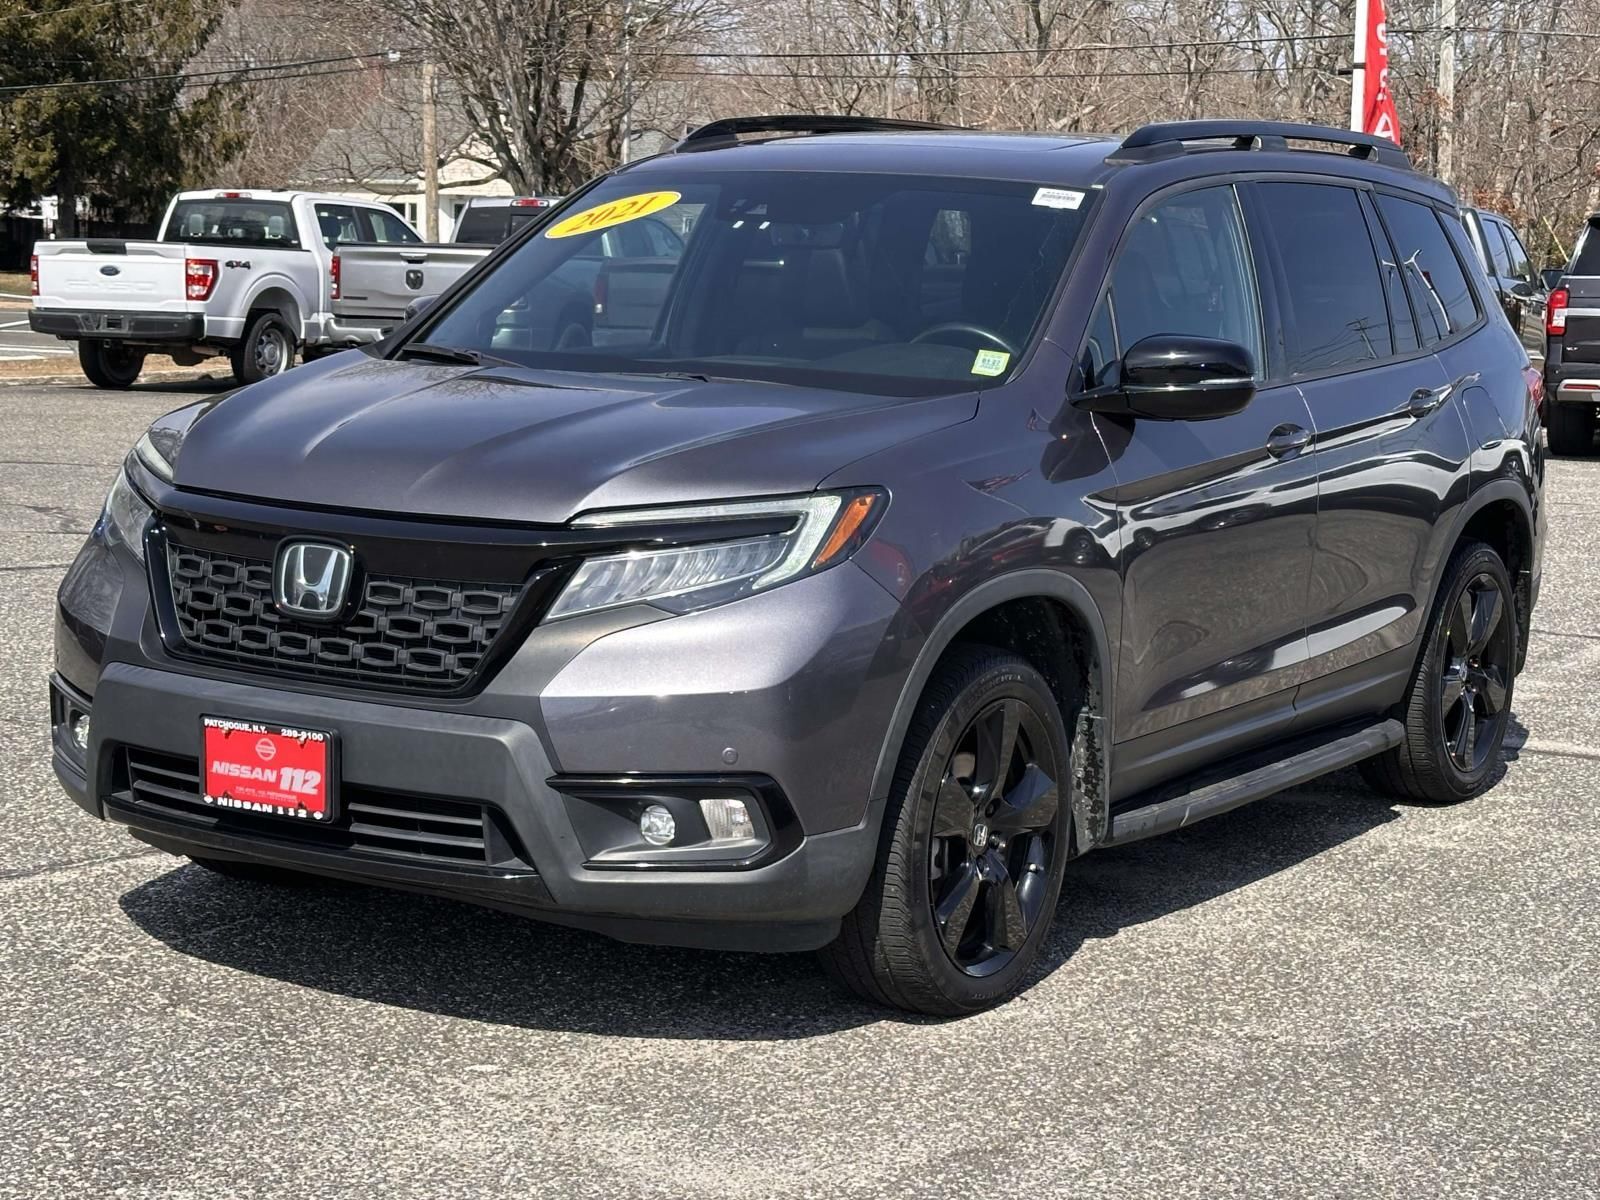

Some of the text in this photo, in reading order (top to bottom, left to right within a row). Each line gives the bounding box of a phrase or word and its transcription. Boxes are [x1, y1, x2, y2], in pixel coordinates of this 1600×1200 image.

[565, 195, 658, 233] 2021
[212, 760, 277, 783] NISSAN
[279, 766, 321, 796] 112
[217, 796, 273, 814] NISSAN
